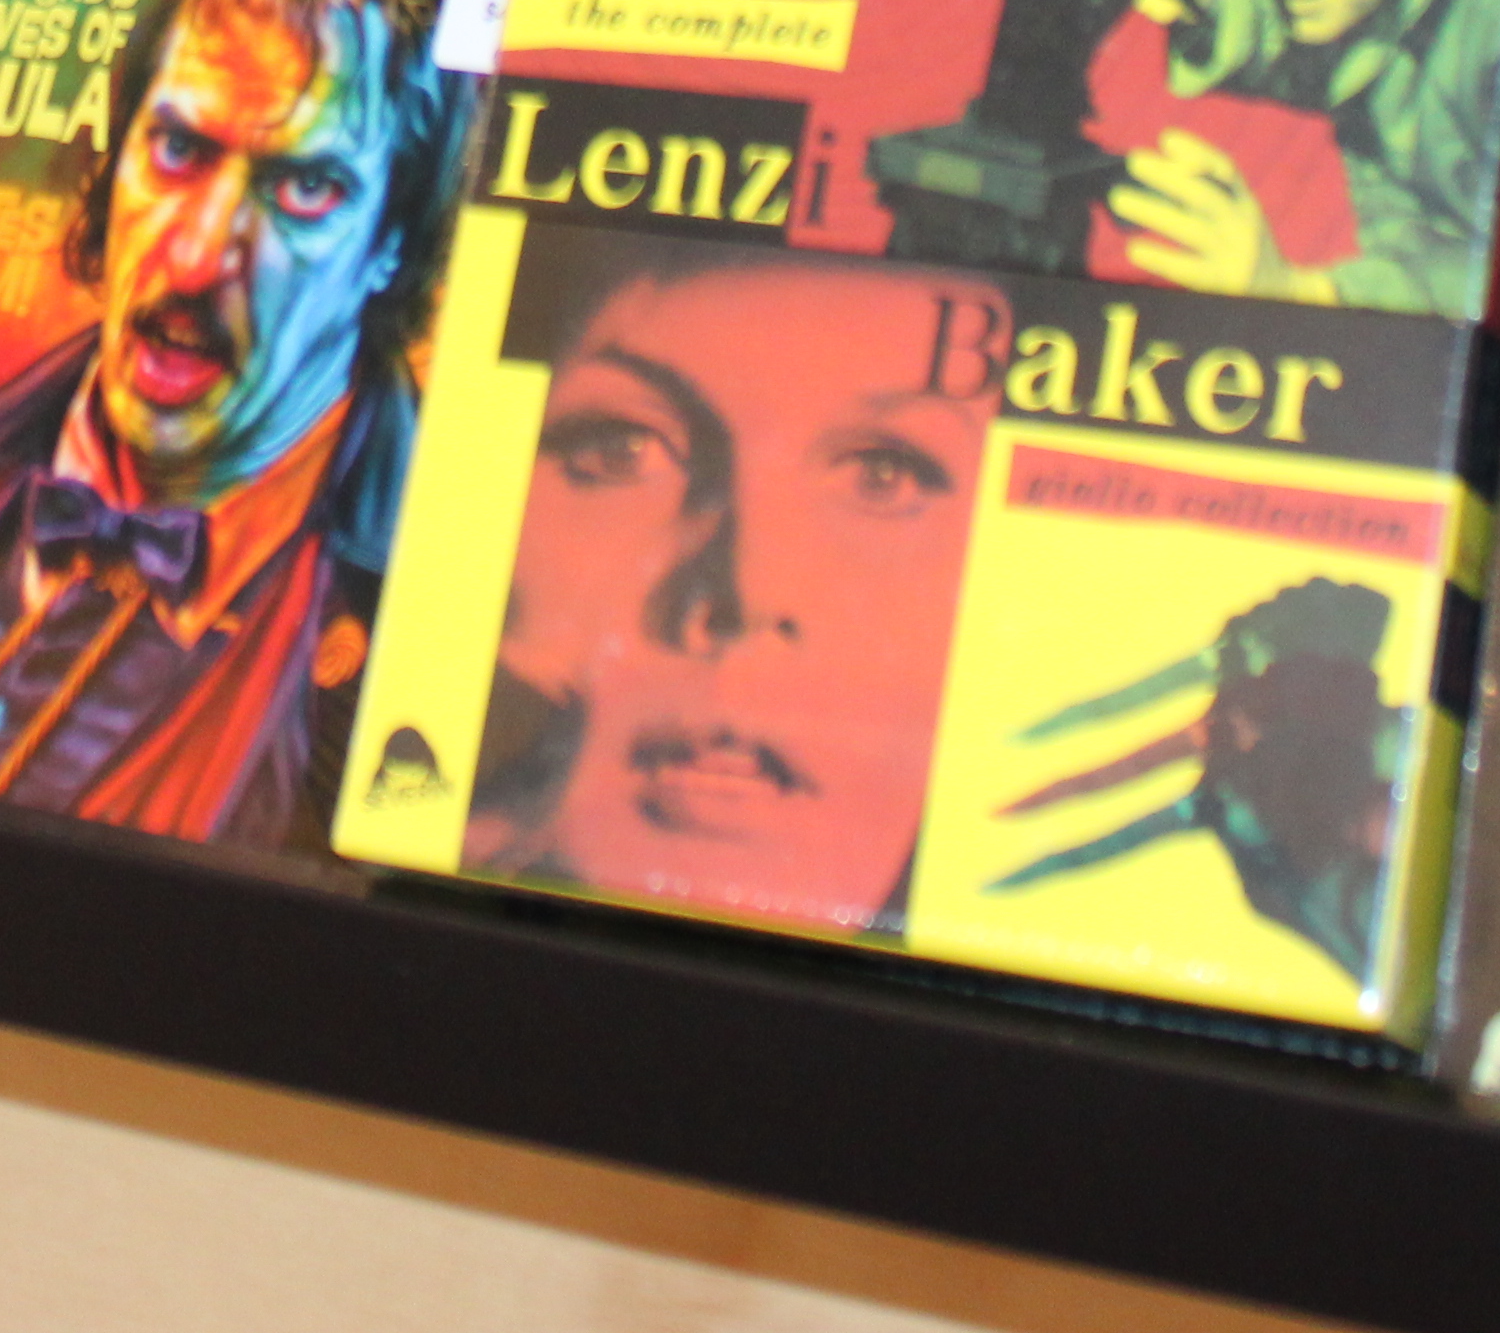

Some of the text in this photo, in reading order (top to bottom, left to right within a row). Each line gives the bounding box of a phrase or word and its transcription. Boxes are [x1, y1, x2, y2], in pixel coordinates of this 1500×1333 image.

[76, 9, 137, 67] OF
[646, 10, 831, 54] complete
[492, 91, 836, 228] Lenzi
[920, 291, 1344, 445] Baker
[1177, 488, 1409, 547] collection
